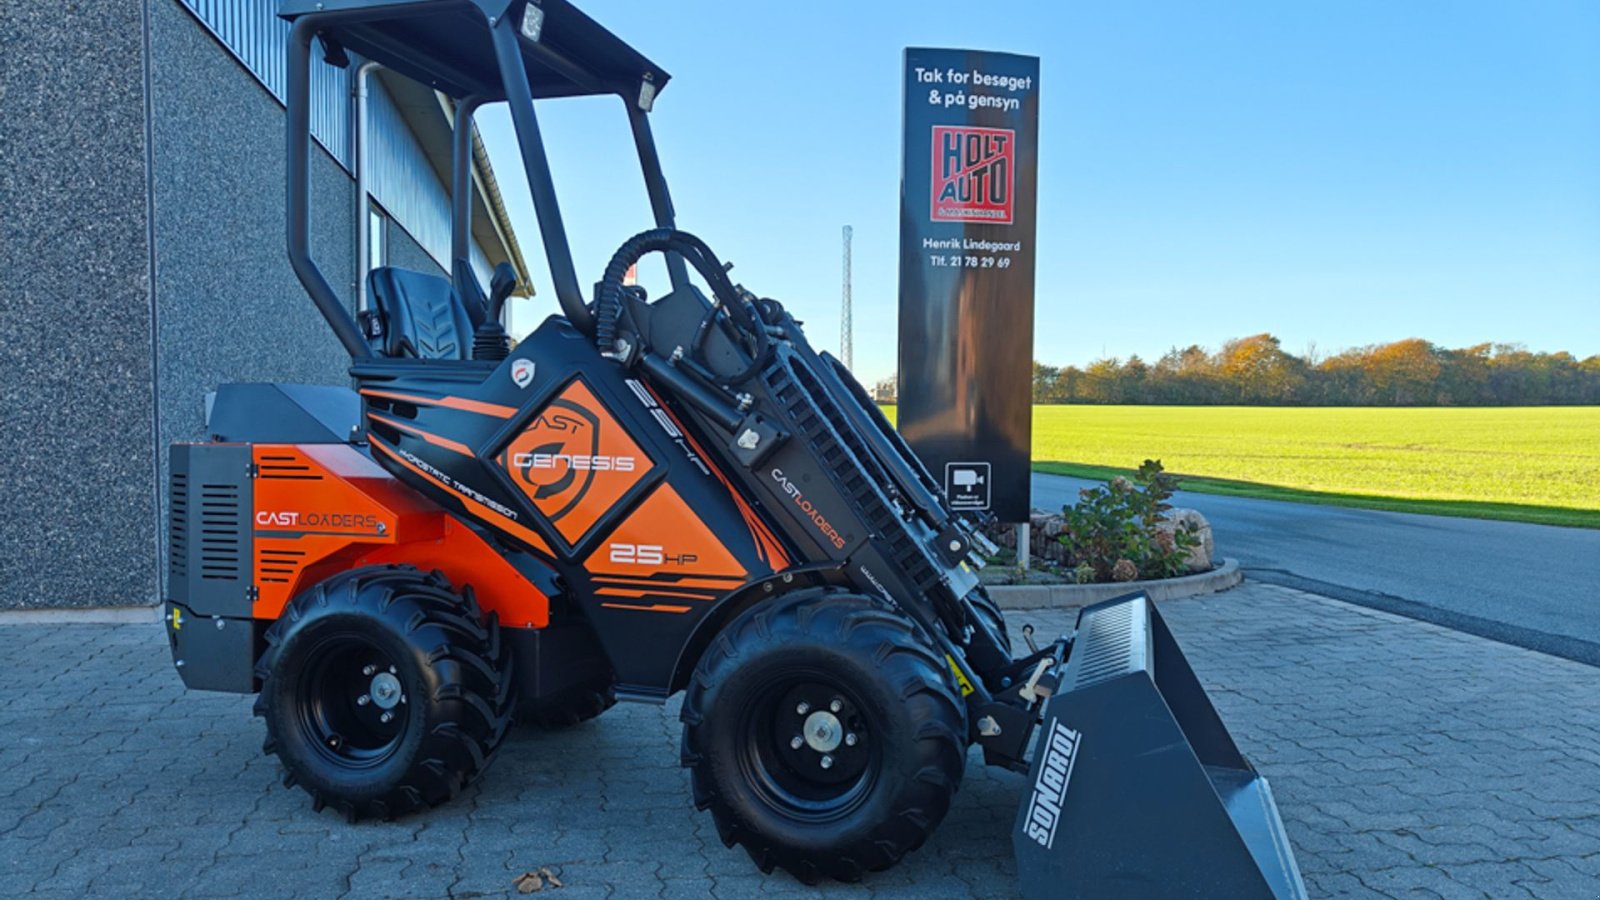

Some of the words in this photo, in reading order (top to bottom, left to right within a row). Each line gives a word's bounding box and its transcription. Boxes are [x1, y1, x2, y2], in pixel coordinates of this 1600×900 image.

[915, 68, 943, 83] Tak
[946, 69, 970, 84] for
[973, 70, 1031, 91] besøget
[928, 90, 942, 105] &
[944, 90, 965, 108] på
[968, 95, 1020, 111] gensyn
[941, 130, 1008, 181] HOLT
[937, 154, 1008, 206] AUTO
[922, 238, 960, 250] Henrik
[963, 238, 1021, 253] Lindegaard
[930, 255, 947, 267] Tlf.
[950, 255, 962, 267] 21
[965, 256, 978, 268] 78
[981, 256, 995, 268] 29
[997, 257, 1010, 269] 69
[513, 452, 635, 472] GENESIS
[1028, 722, 1077, 846] SONAROL
